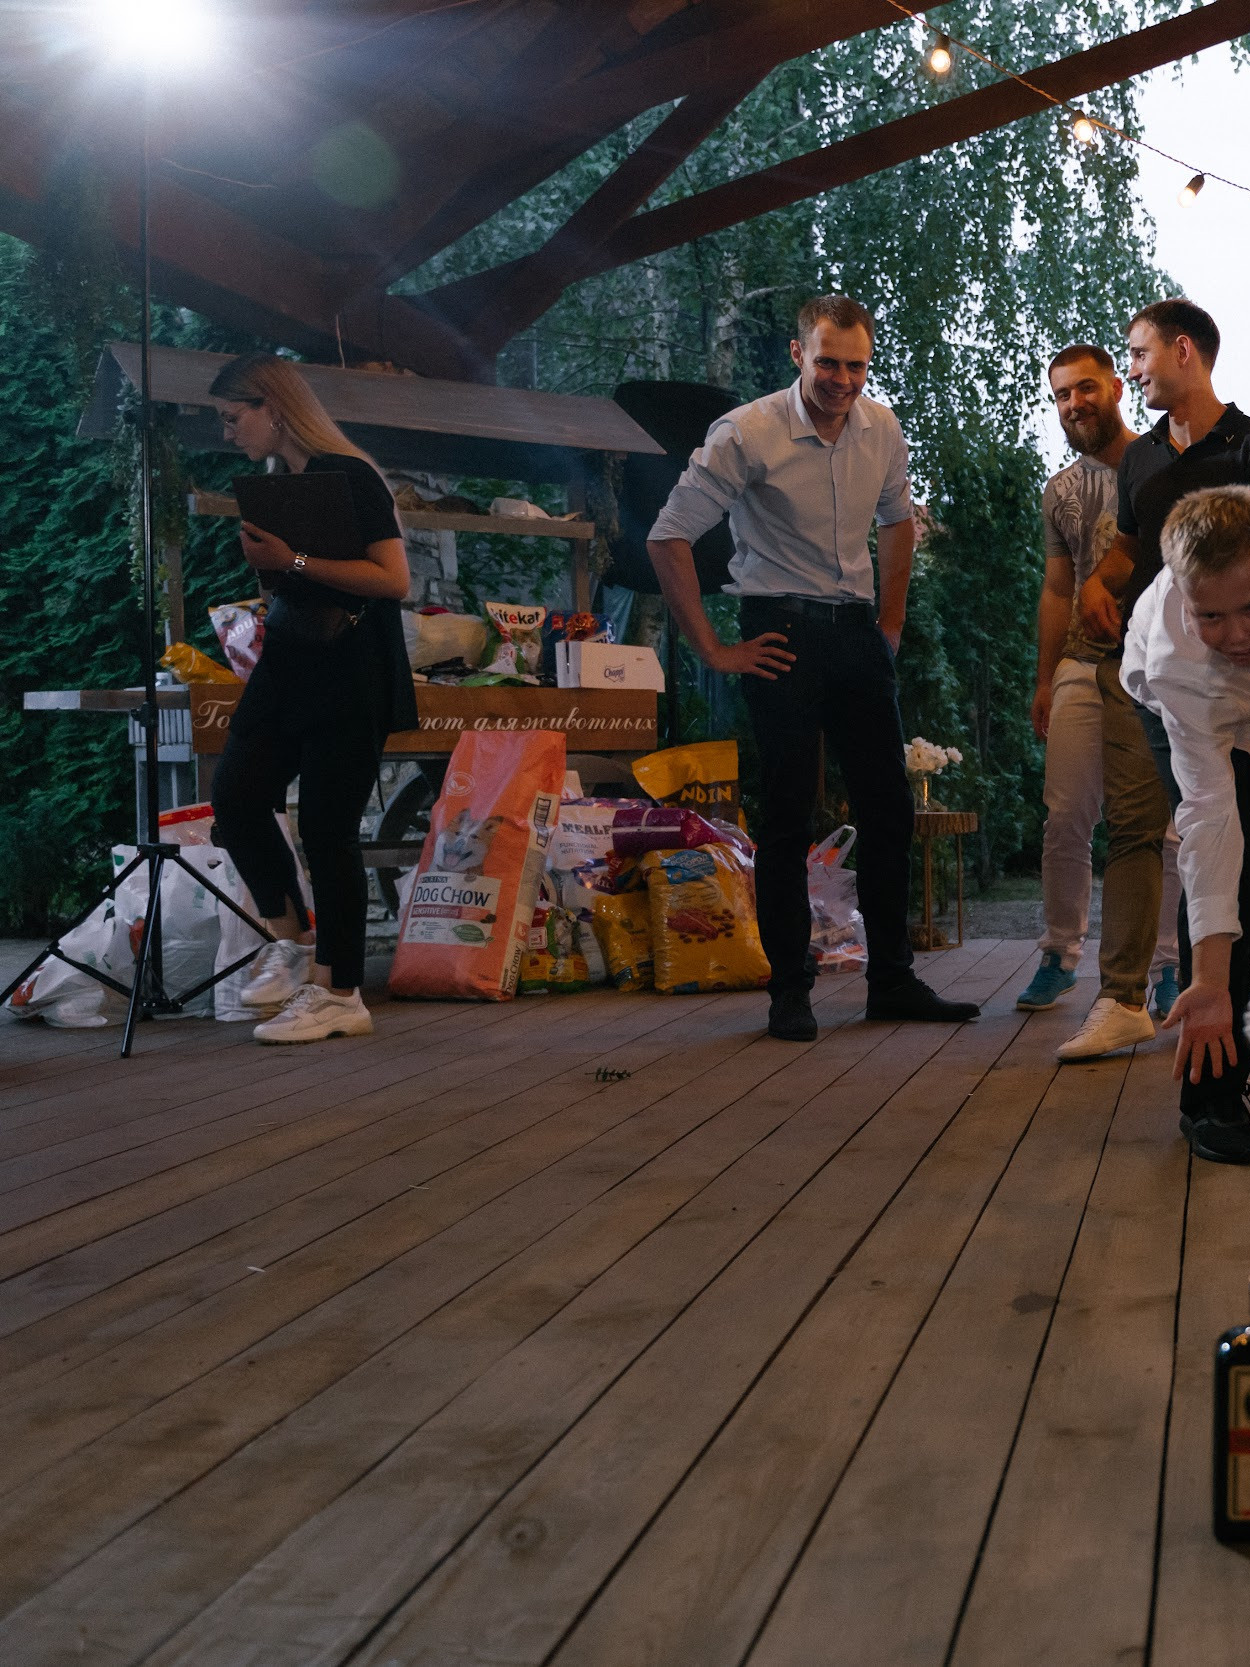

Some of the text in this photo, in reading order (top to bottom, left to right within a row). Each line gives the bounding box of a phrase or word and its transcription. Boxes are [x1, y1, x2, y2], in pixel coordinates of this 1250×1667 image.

[226, 615, 265, 641] ADUL
[417, 716, 466, 731] ют
[472, 717, 518, 731] для
[520, 706, 657, 730] животных
[414, 886, 491, 907] DOG CHOW
